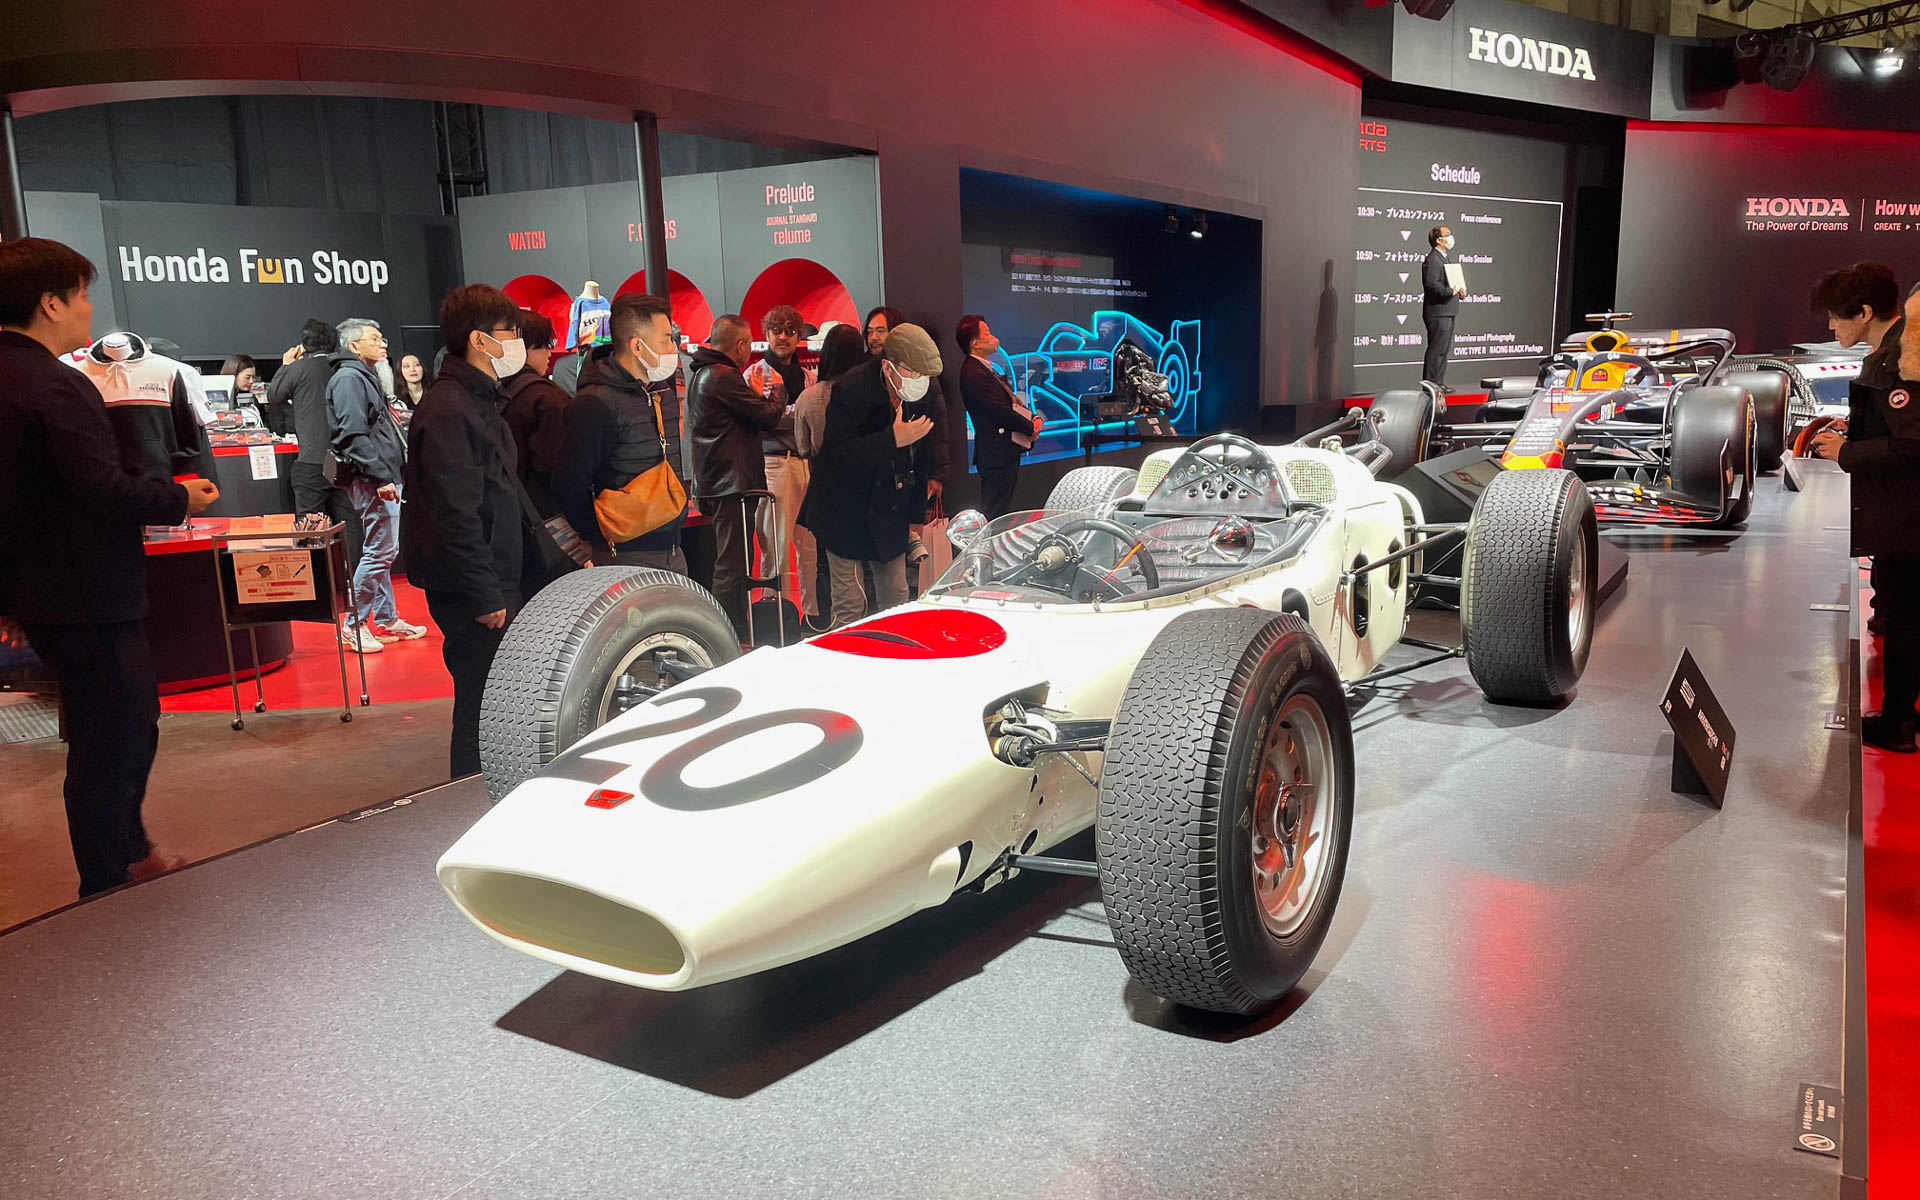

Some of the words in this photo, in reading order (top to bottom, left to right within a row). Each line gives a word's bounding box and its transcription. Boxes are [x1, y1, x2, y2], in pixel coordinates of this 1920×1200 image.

[1468, 27, 1596, 82] HONDA
[1431, 163, 1481, 185] Schedule
[765, 182, 815, 205] Prelude
[1745, 198, 1850, 217] HONDA
[1875, 200, 1907, 216] How
[766, 215, 789, 227] JOURNAL
[789, 212, 818, 225] STANDARD
[1745, 221, 1764, 231] The
[1766, 221, 1797, 231] Power
[1799, 221, 1810, 231] of
[1811, 221, 1849, 231] Dreams
[1873, 223, 1901, 231] CREATE
[508, 230, 547, 251] WATCH
[773, 227, 812, 246] relume
[118, 245, 229, 284] Honda
[239, 248, 304, 285] Fun
[313, 250, 389, 293] Shop
[577, 686, 593, 739] UNLOP
[531, 686, 864, 812] 20
